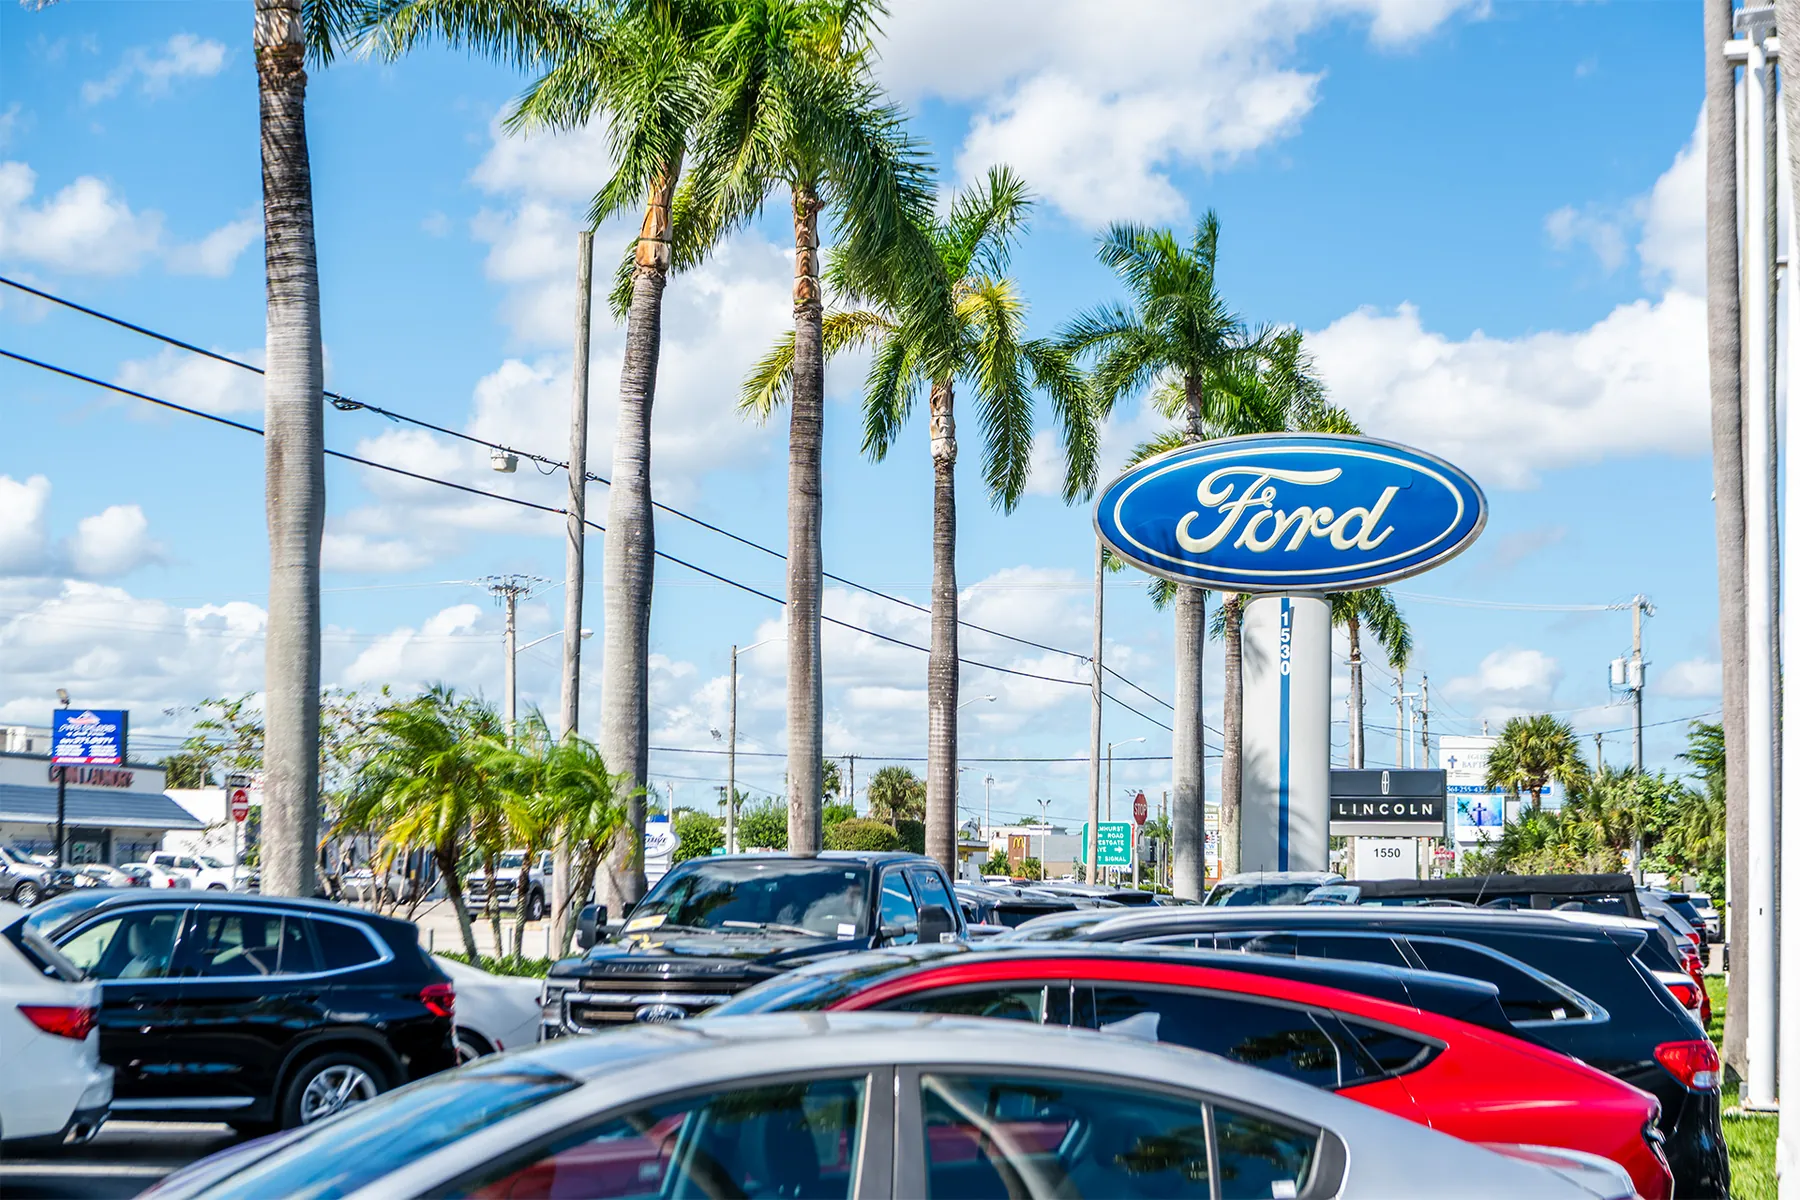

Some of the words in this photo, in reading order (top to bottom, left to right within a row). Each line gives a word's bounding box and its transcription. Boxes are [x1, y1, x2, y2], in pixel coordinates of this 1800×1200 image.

[1176, 466, 1400, 553] Ford
[1280, 611, 1290, 676] 1530
[1134, 803, 1147, 816] STOP
[1339, 803, 1433, 815] LINCOLN
[1373, 847, 1401, 858] 1550
